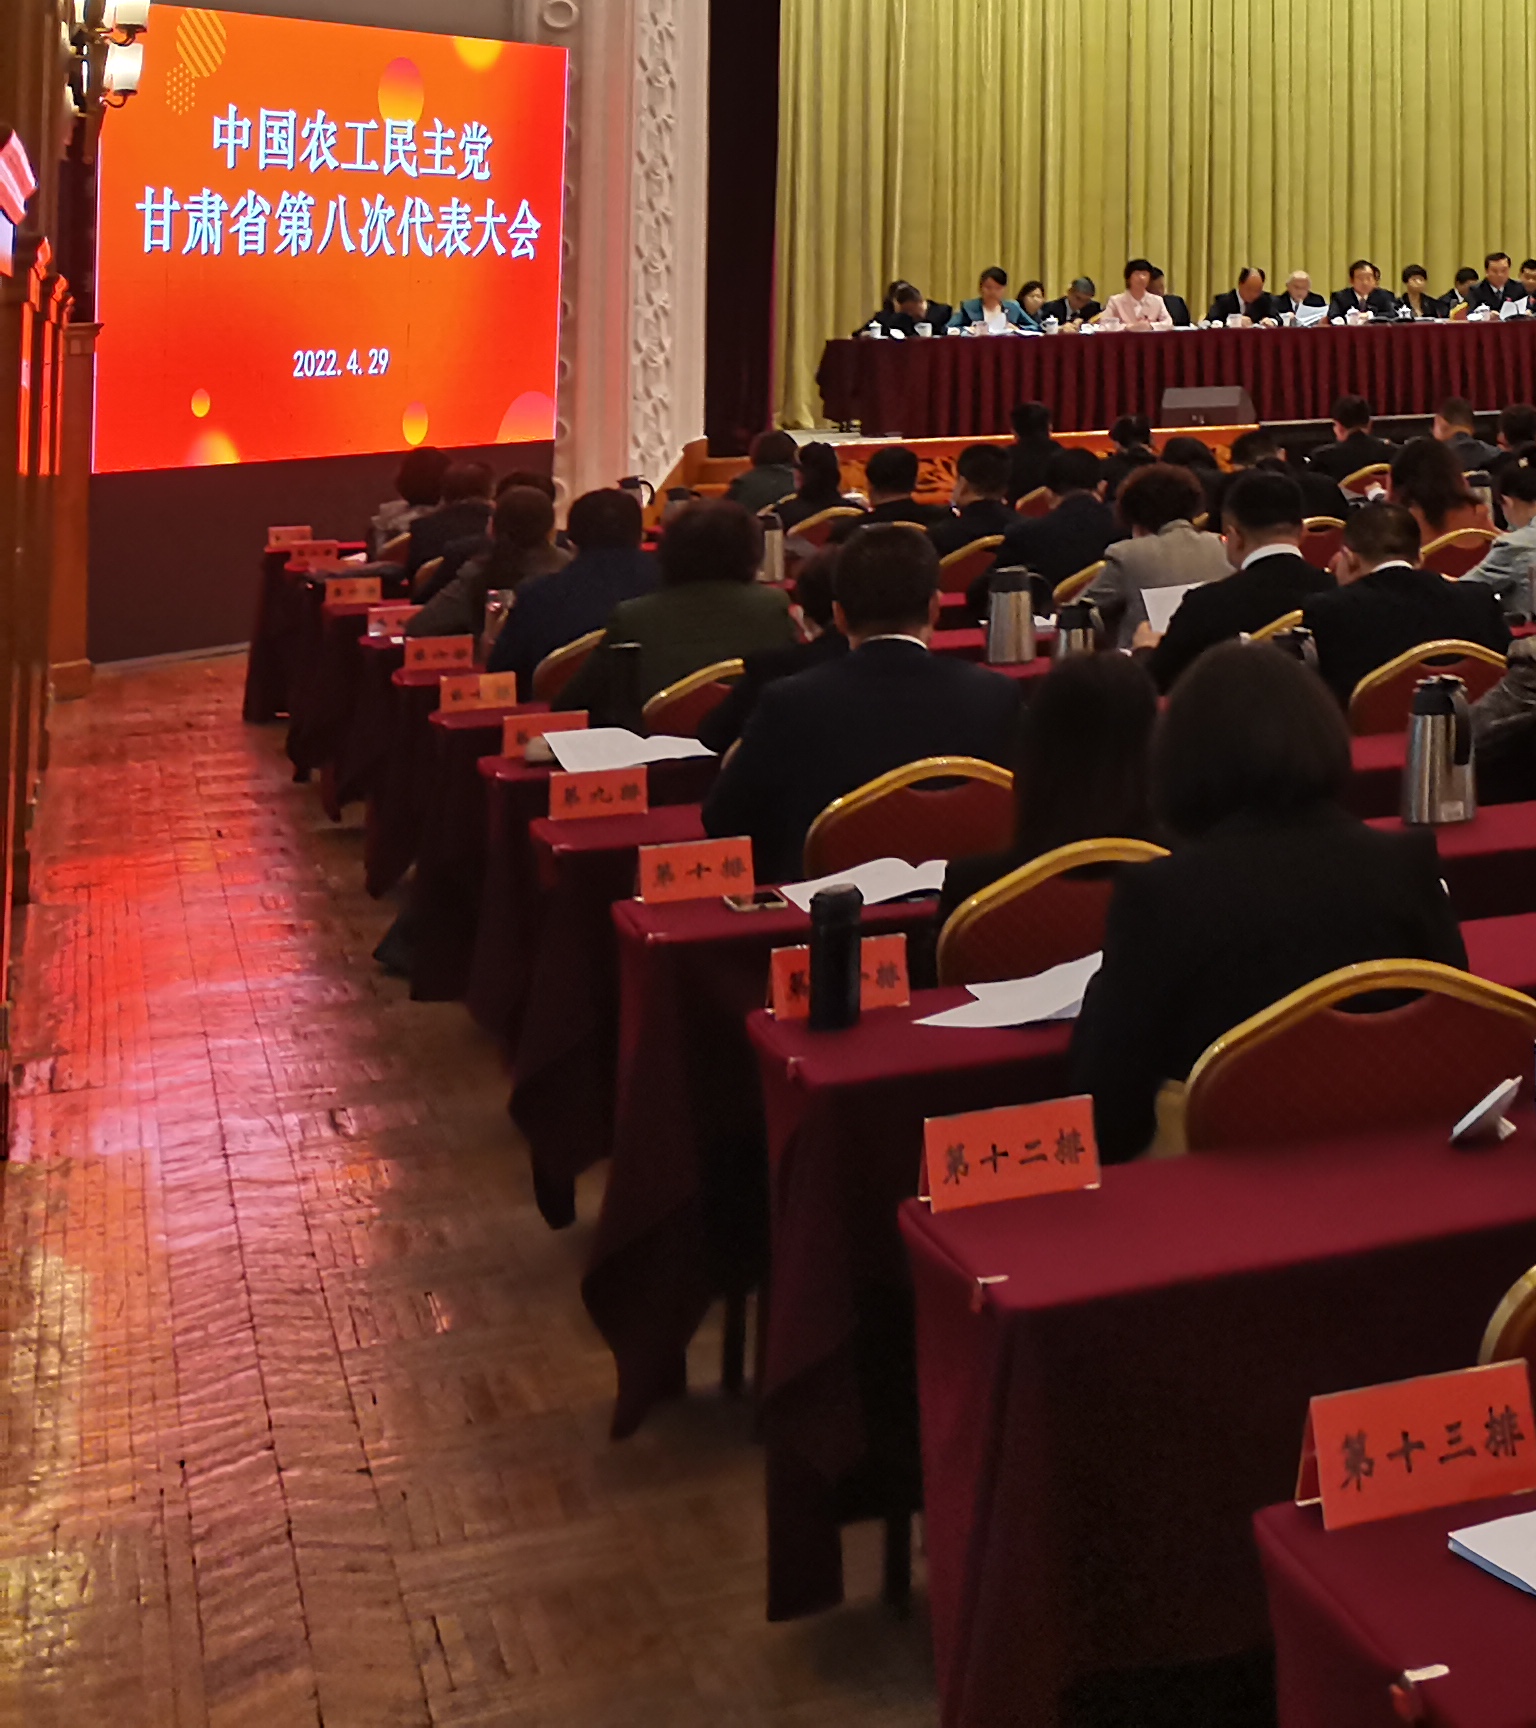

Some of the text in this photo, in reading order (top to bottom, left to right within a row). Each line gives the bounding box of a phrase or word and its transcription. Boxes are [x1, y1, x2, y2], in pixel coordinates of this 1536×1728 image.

[212, 103, 493, 180] 中国农工民主党
[135, 186, 541, 260] 甘肃省第八次代表大会
[943, 1127, 1085, 1185] 第十二排
[1341, 1405, 1525, 1491] 第十三排
